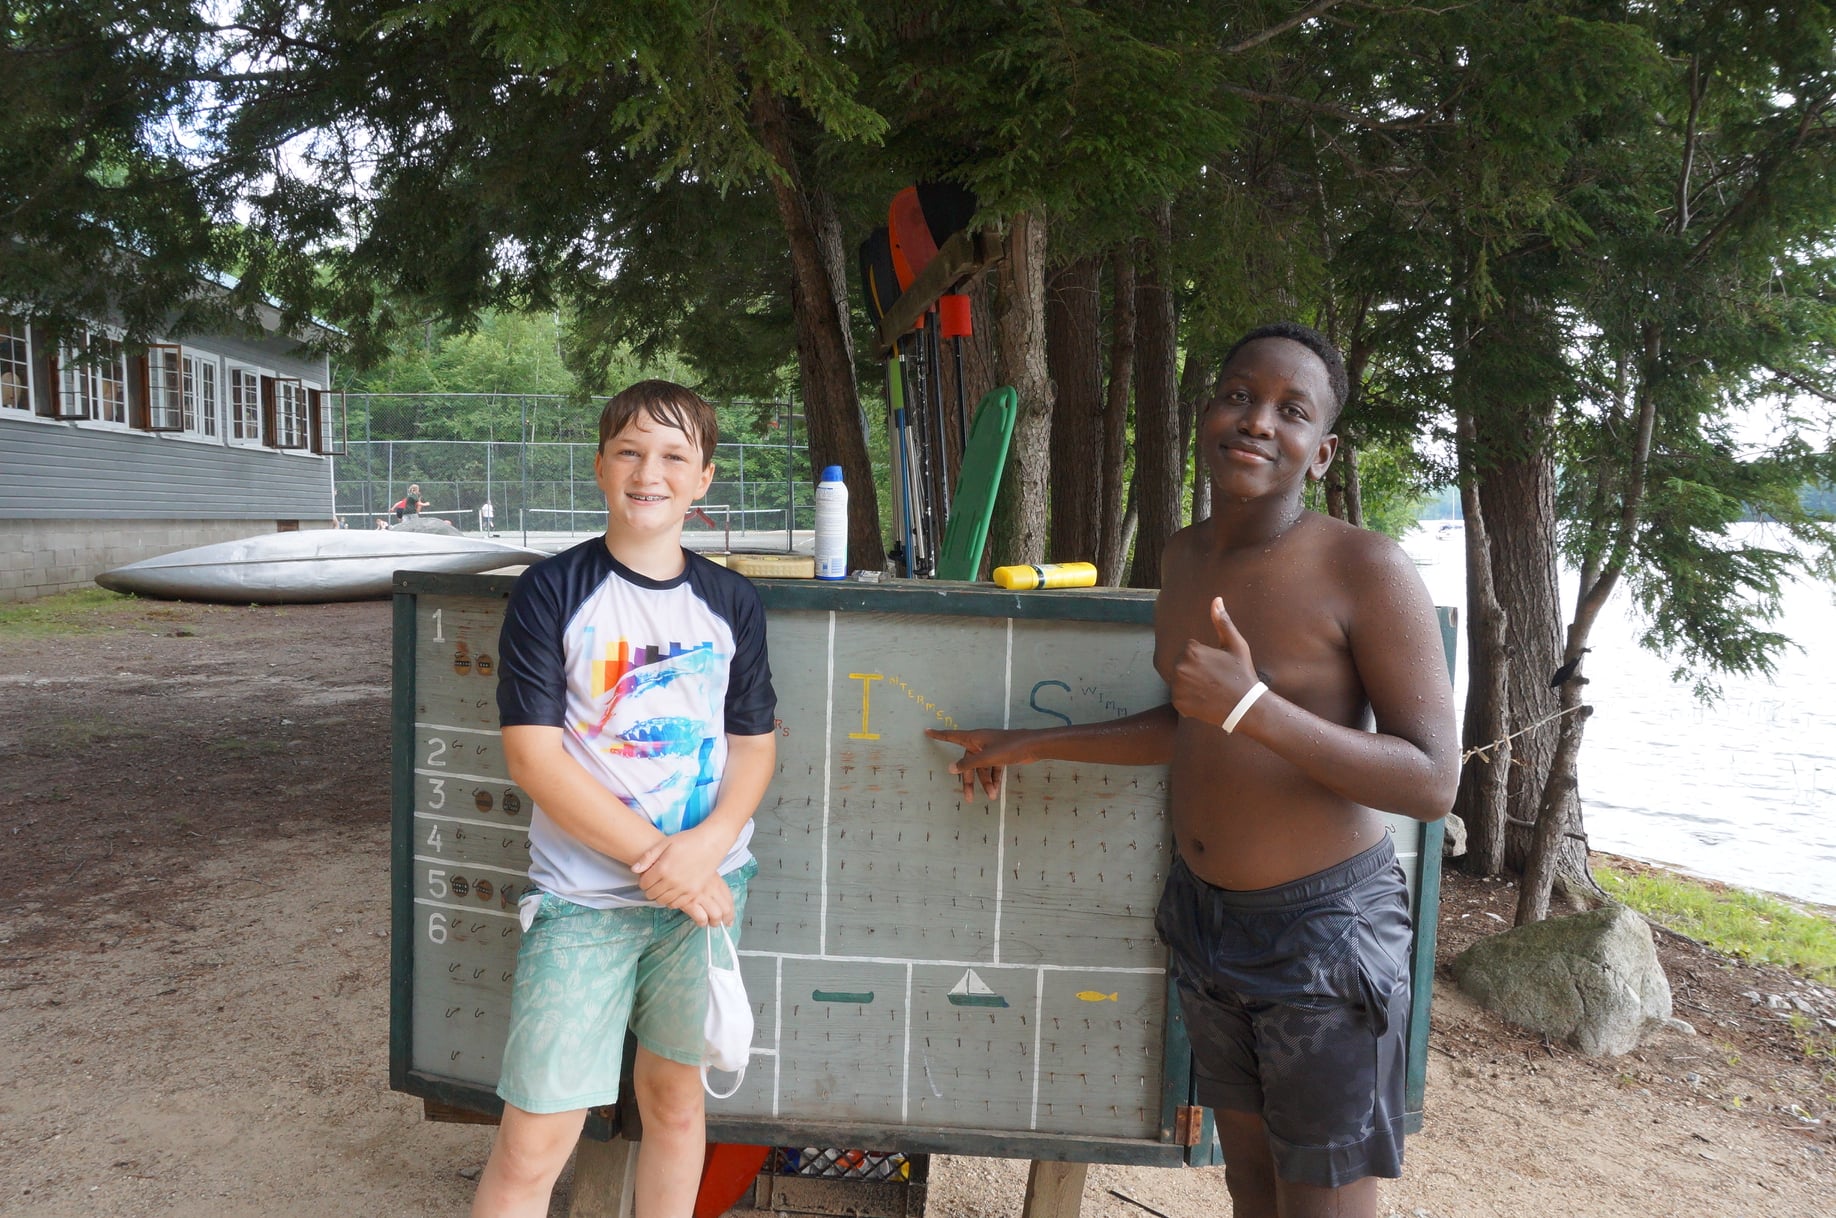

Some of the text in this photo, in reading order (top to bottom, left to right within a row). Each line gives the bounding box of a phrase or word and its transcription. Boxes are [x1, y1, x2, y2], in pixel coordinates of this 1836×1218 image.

[432, 608, 446, 643] 1
[427, 737, 446, 766] 2
[428, 778, 446, 809] 3
[427, 824, 442, 853] 4
[428, 869, 447, 899] 5
[428, 912, 448, 945] 6
